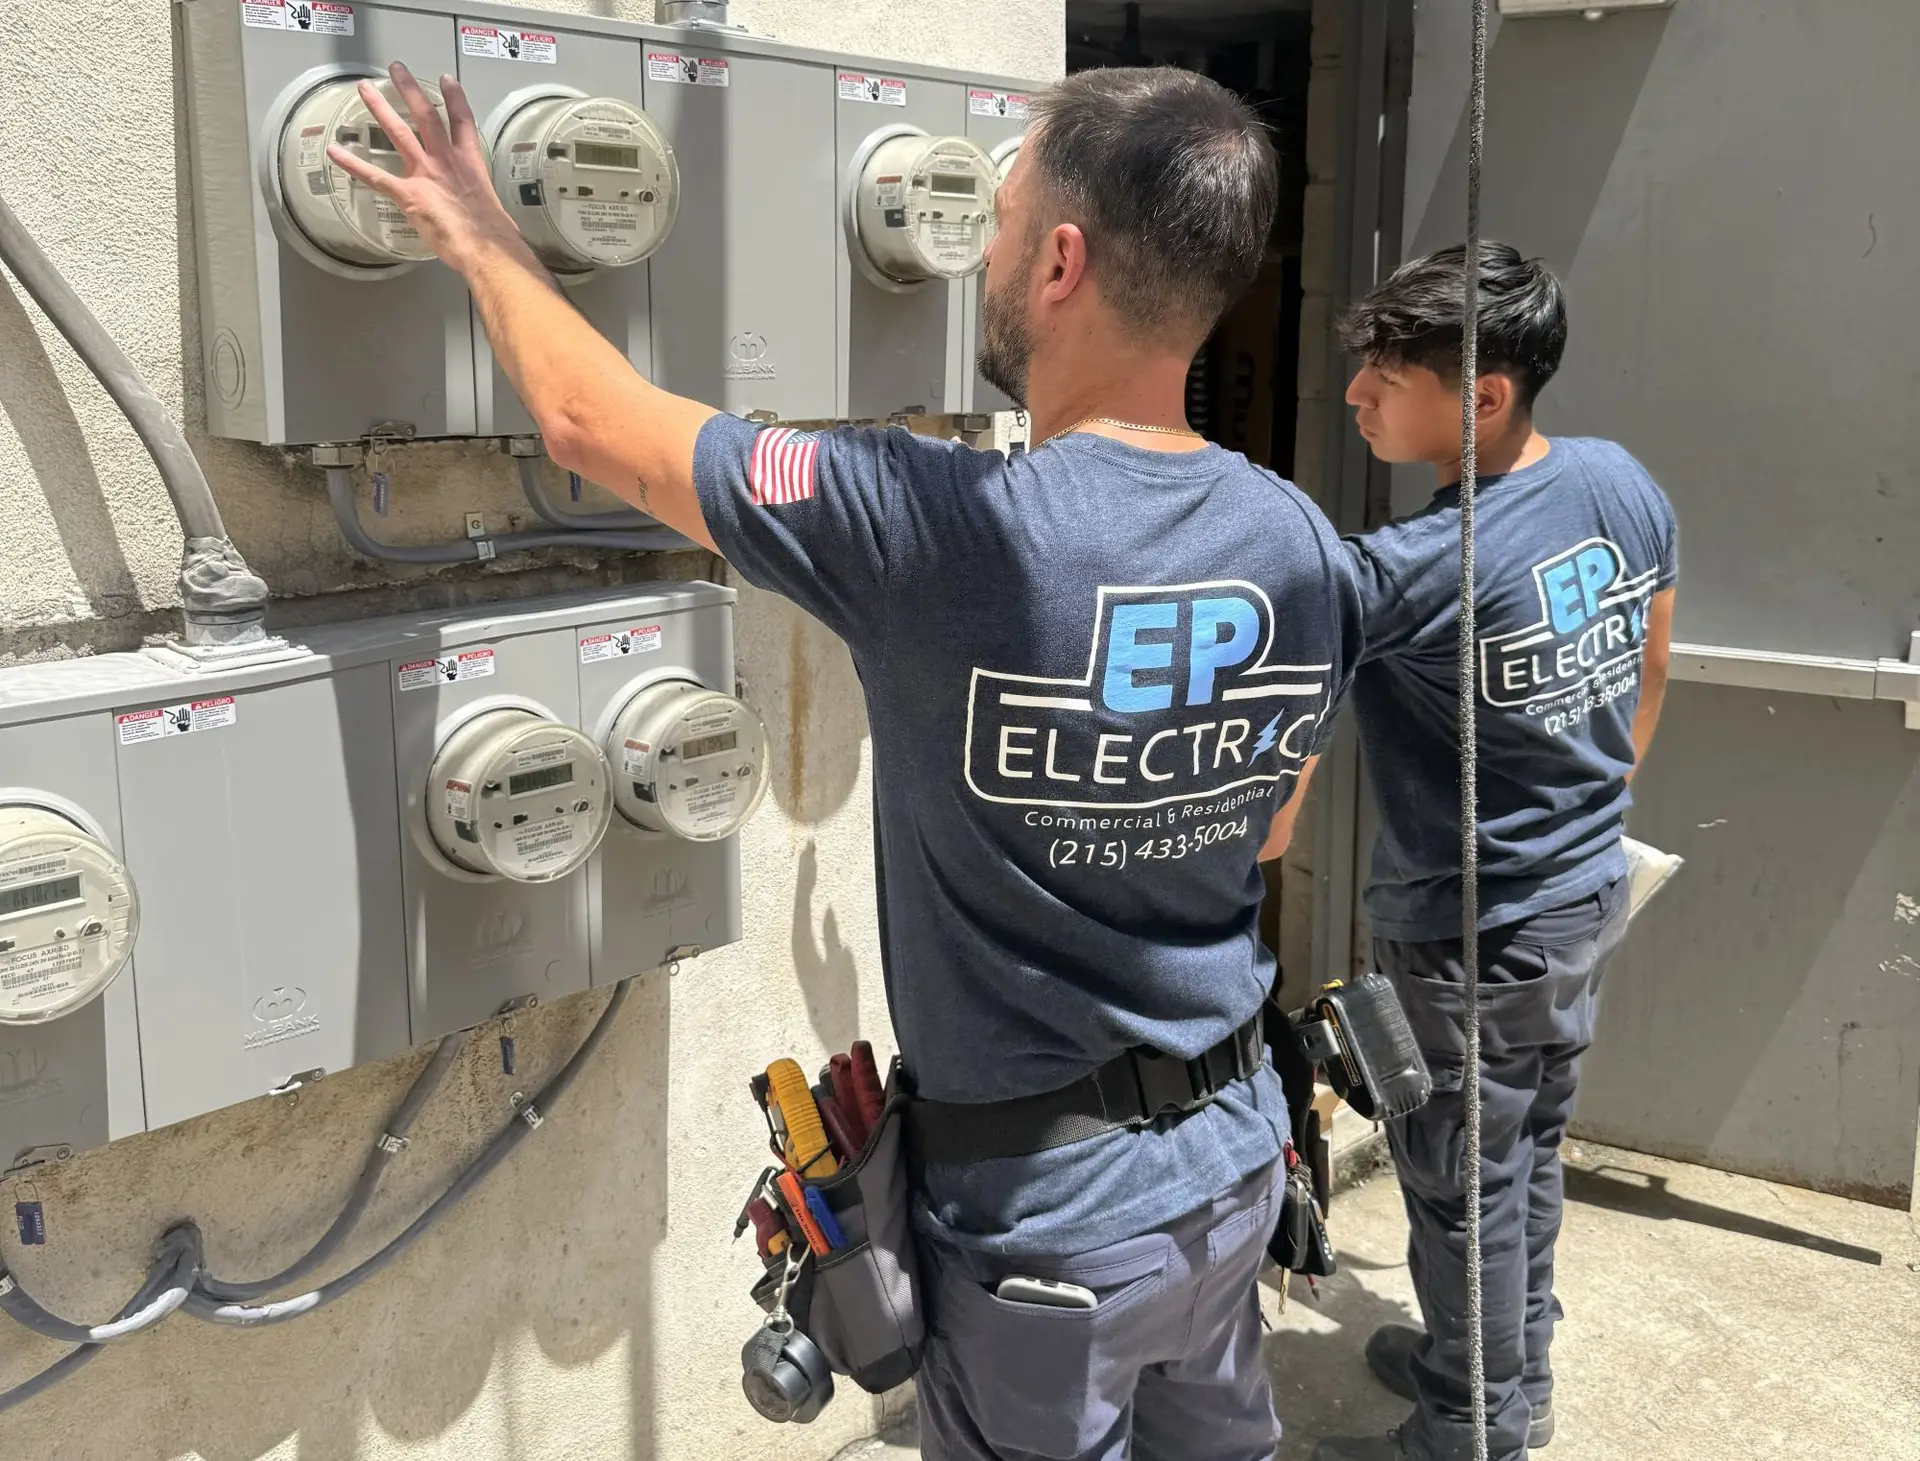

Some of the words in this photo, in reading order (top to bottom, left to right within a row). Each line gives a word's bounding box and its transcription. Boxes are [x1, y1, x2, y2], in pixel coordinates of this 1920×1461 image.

[321, 3, 350, 13] PELIGRO
[470, 28, 495, 36] DANGER
[1544, 547, 1616, 634] EP
[1103, 597, 1260, 713] EP
[408, 660, 433, 670] DANGER
[202, 697, 231, 708] PELIGRO
[129, 711, 160, 721] DANGER
[1024, 811, 1161, 830] Commercial
[1167, 808, 1176, 823] &
[1181, 785, 1274, 820] Residential
[1049, 839, 1127, 869] (215)
[1134, 815, 1249, 860] 433-5004
[12, 951, 37, 963] FOCUS
